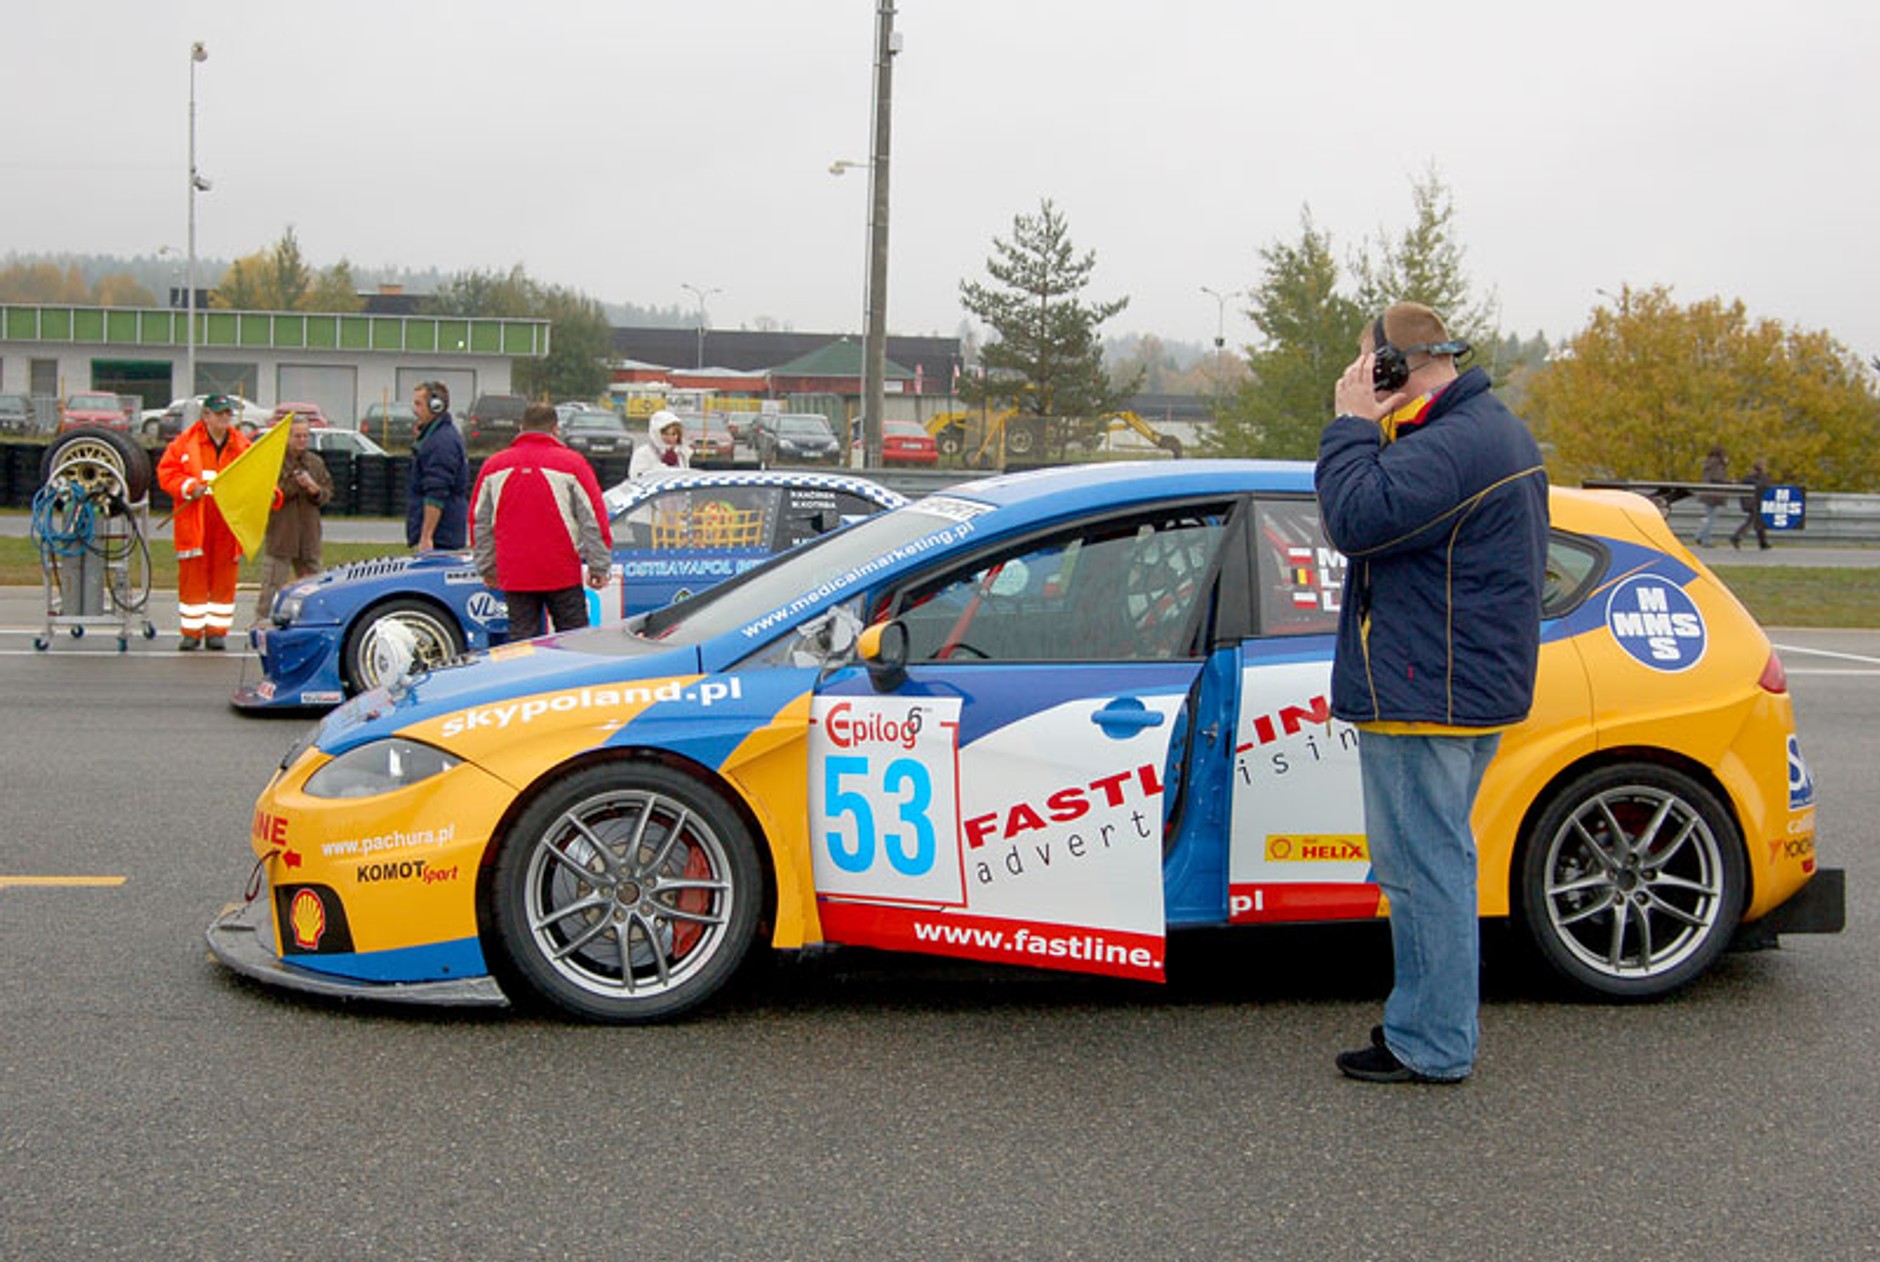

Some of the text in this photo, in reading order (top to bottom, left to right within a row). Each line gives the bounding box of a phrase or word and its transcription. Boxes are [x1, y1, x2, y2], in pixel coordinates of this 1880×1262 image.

[742, 521, 975, 639] www.medicalmarketing.pl
[441, 677, 741, 737] skypoland.pl
[825, 702, 916, 749] Epilog
[825, 755, 936, 876] 53
[964, 763, 1164, 849] FASTL
[321, 823, 455, 856] www.pachura.pl
[977, 810, 1150, 884] advert
[1302, 846, 1363, 859] HELIX
[914, 921, 1164, 969] www.fastline.
